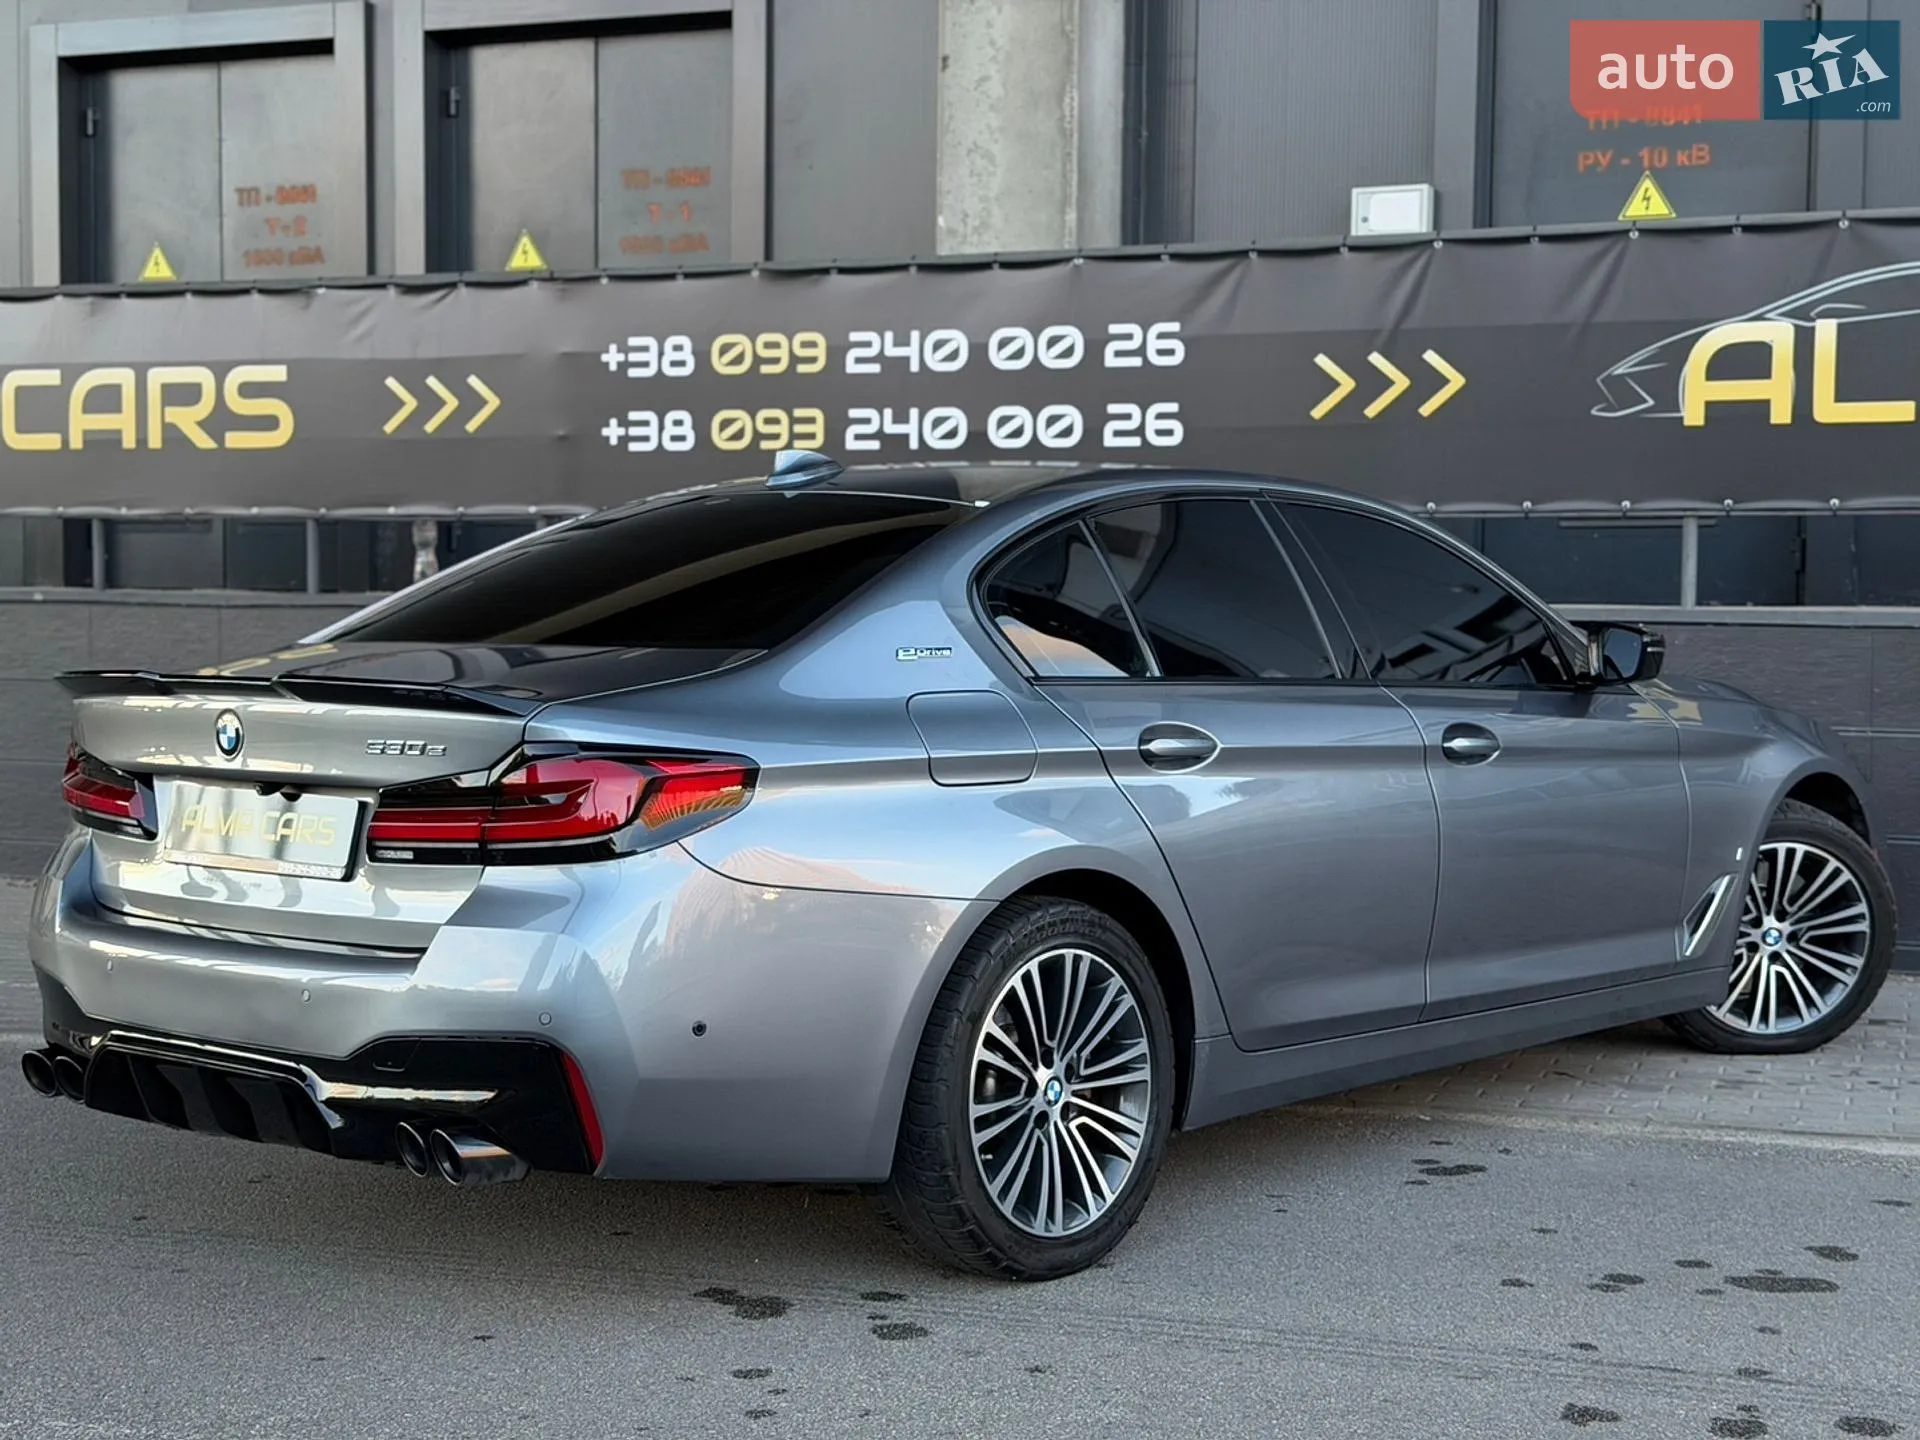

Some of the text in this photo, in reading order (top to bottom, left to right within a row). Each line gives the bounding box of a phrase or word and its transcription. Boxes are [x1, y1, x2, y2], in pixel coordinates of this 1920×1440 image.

[1577, 150, 1613, 174] РУ
[1639, 147, 1669, 169] 10
[600, 321, 1187, 377] +38 099 240 00 26
[0, 365, 295, 452] CARS
[600, 402, 1185, 452] +38 093 240 00 26
[181, 803, 338, 847] ALMA CARS
